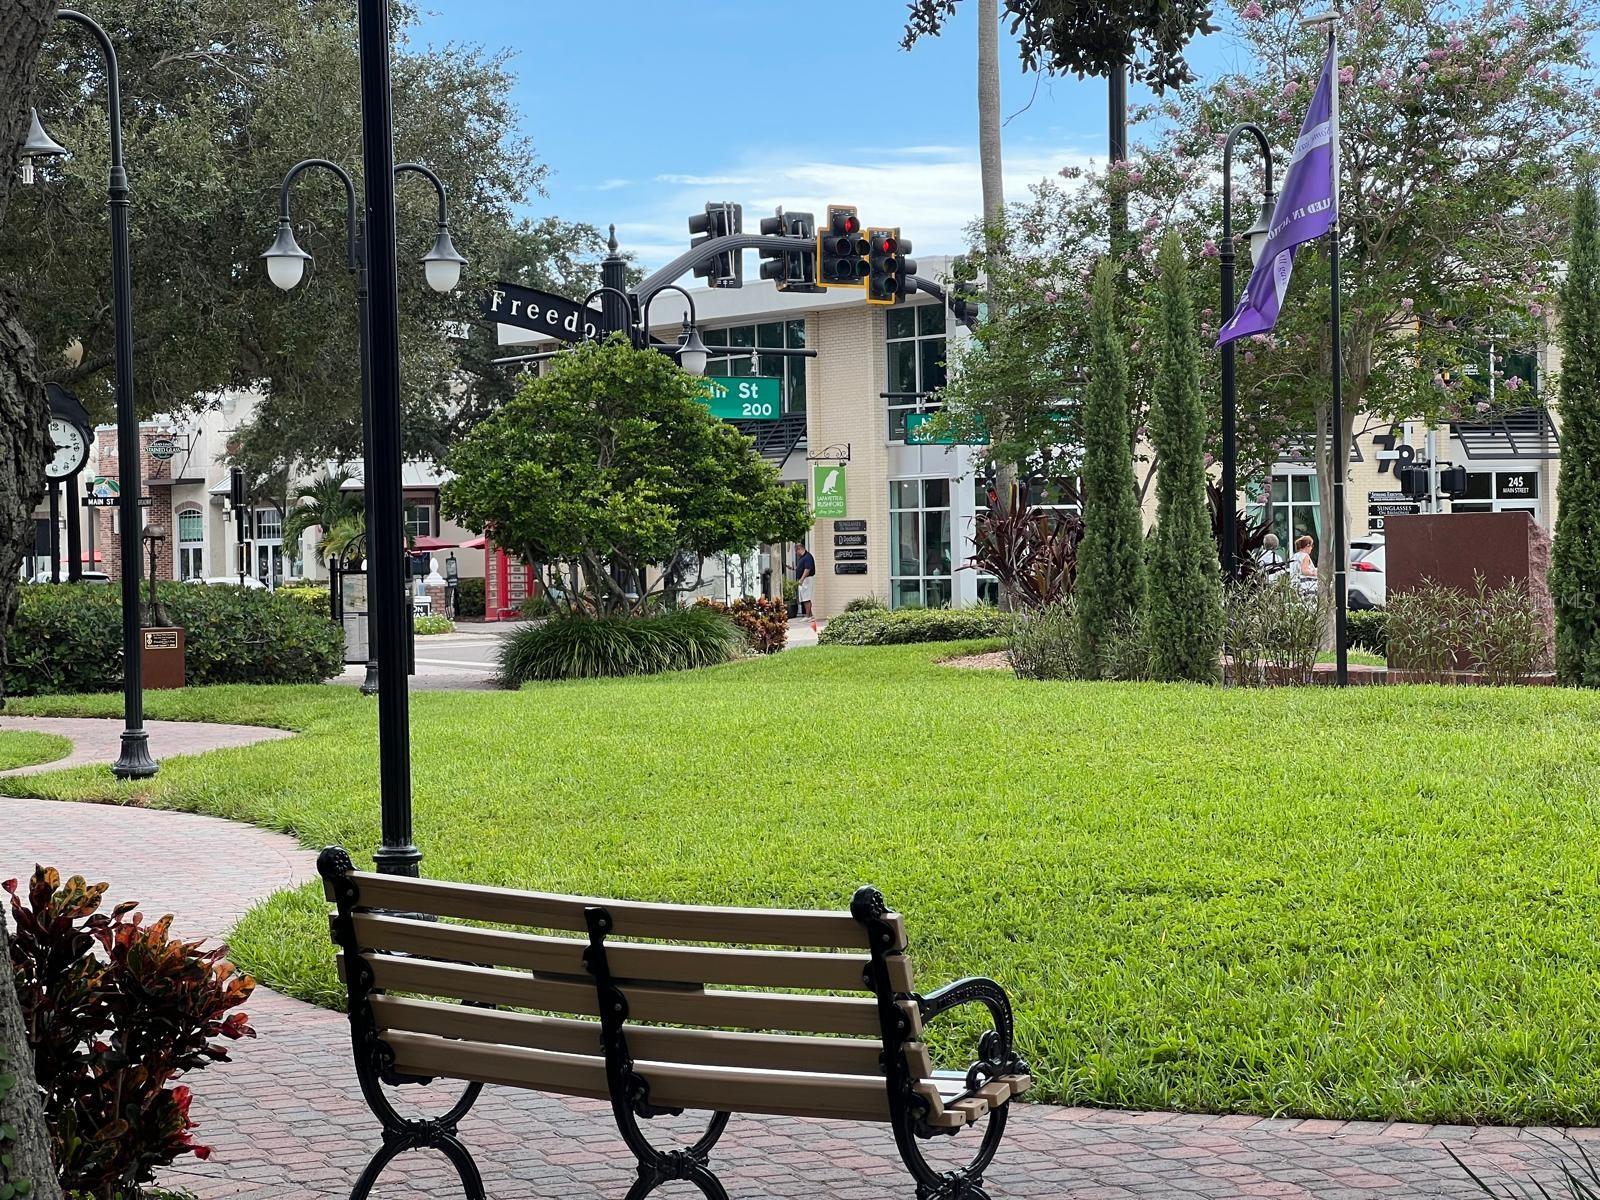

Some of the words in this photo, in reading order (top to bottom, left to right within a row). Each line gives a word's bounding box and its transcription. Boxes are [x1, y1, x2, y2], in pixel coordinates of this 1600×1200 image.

[738, 382, 759, 399] St
[742, 403, 772, 416] 200
[1508, 476, 1524, 487] 245
